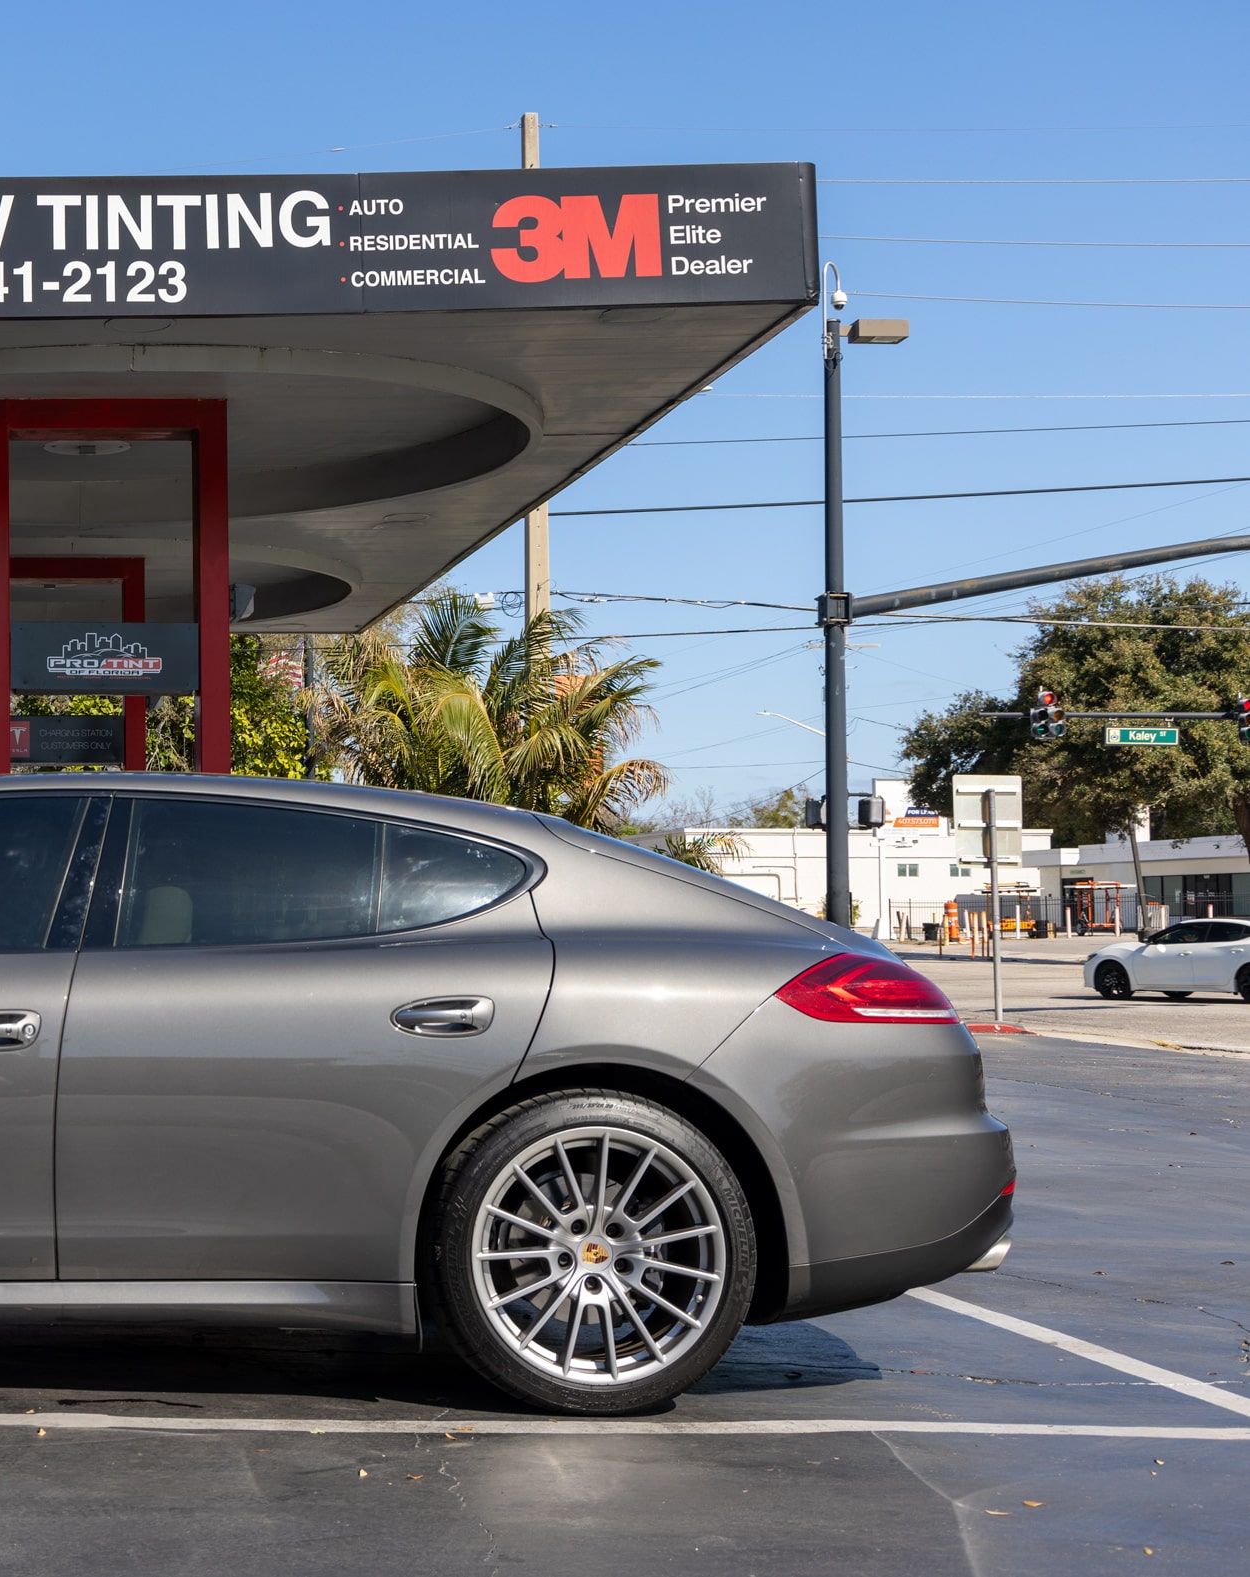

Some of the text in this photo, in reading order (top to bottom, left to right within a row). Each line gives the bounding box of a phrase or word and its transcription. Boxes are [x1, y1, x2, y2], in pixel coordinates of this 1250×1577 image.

[349, 199, 405, 216] AUTO
[668, 193, 767, 215] Premier
[37, 190, 333, 252] TINTING
[350, 233, 480, 252] RESIDENTIAL
[491, 194, 664, 284] 3M
[670, 225, 723, 246] Elite
[671, 255, 755, 276] Dealer
[351, 269, 487, 288] COMMERCIAL
[50, 658, 159, 669] PRO TINT
[39, 729, 113, 737] CHARGING STATION
[1128, 730, 1157, 743] Kaley
[40, 741, 112, 750] CUSTOMERS ONLY
[723, 1187, 749, 1271] MICHELIN
